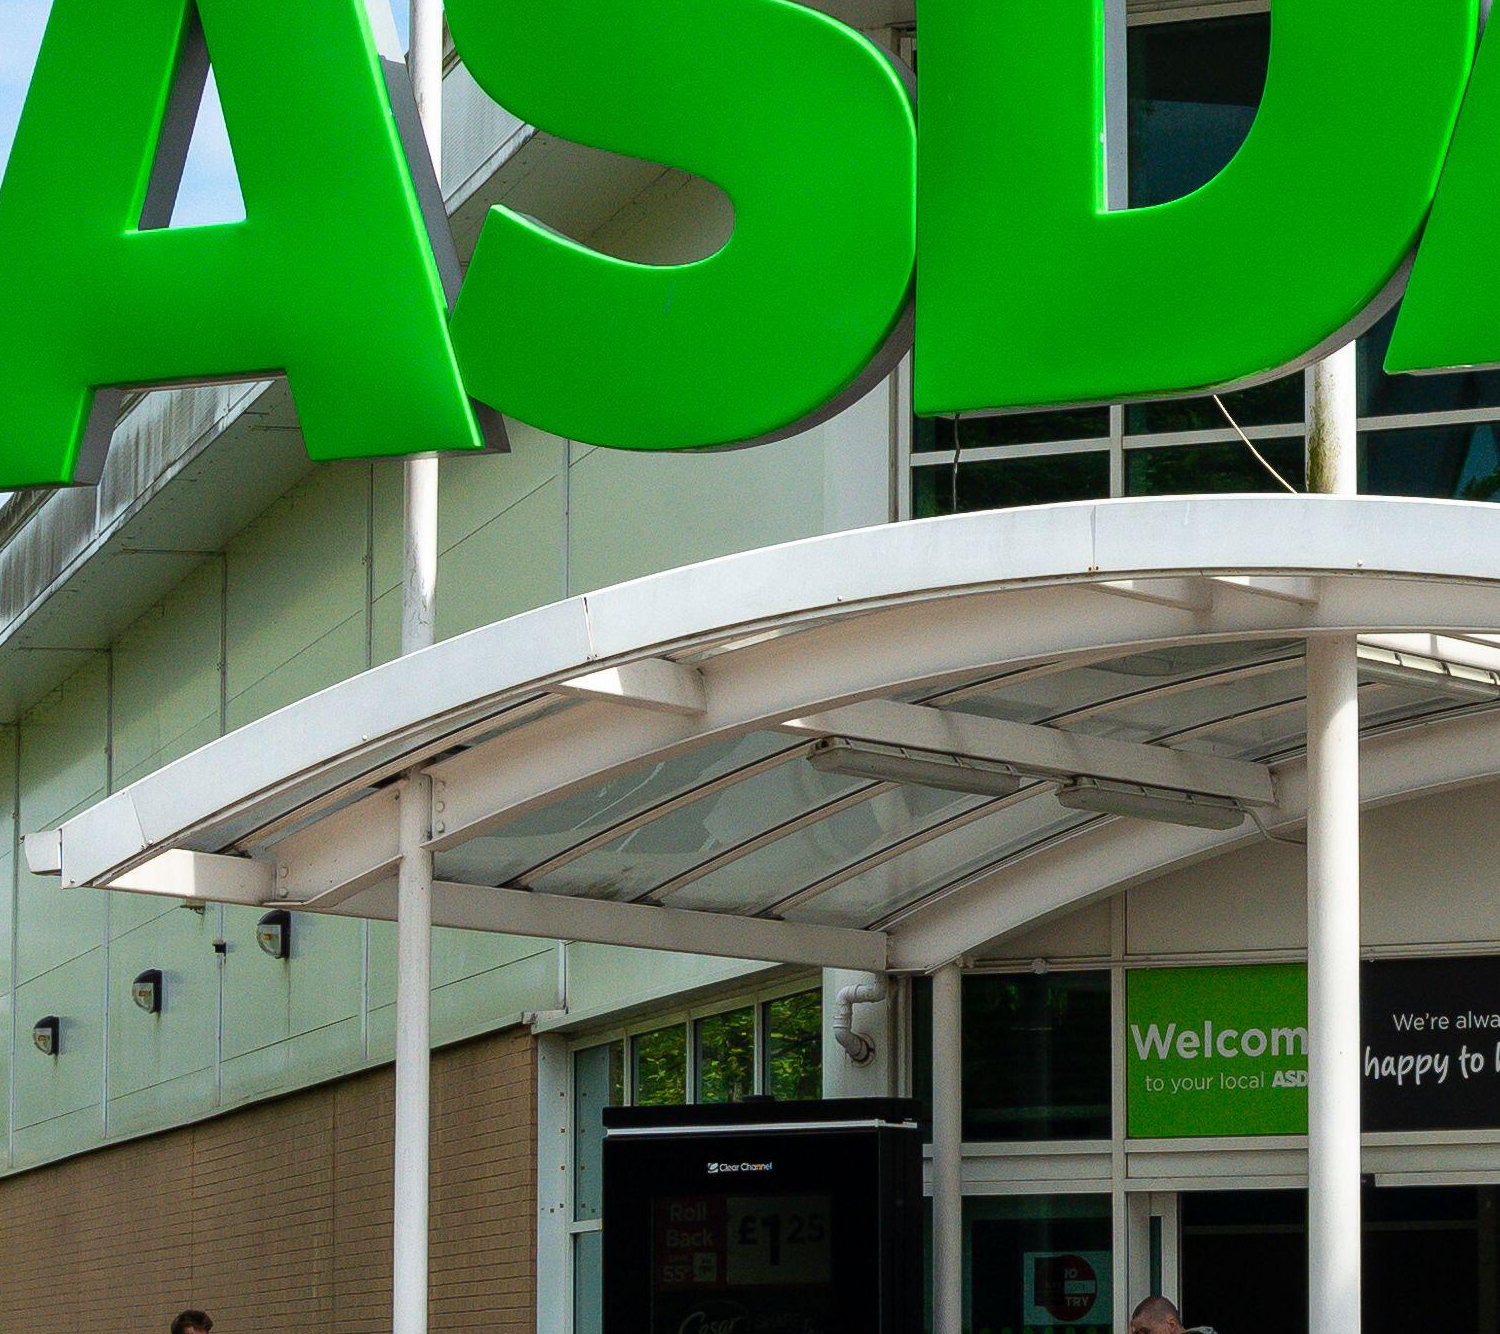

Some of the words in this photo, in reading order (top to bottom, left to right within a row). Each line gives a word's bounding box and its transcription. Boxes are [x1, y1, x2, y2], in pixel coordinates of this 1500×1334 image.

[1131, 1020, 1309, 1060] Welcom
[1364, 1045, 1450, 1085] happy
[1458, 1045, 1485, 1078] to
[1145, 1074, 1164, 1092] to
[1170, 1074, 1214, 1094] your
[1220, 1071, 1265, 1089] local
[1271, 1070, 1309, 1088] ASD
[719, 1163, 740, 1172] Clear
[740, 1161, 773, 1172] Channel
[1066, 1296, 1089, 1307] TRY
